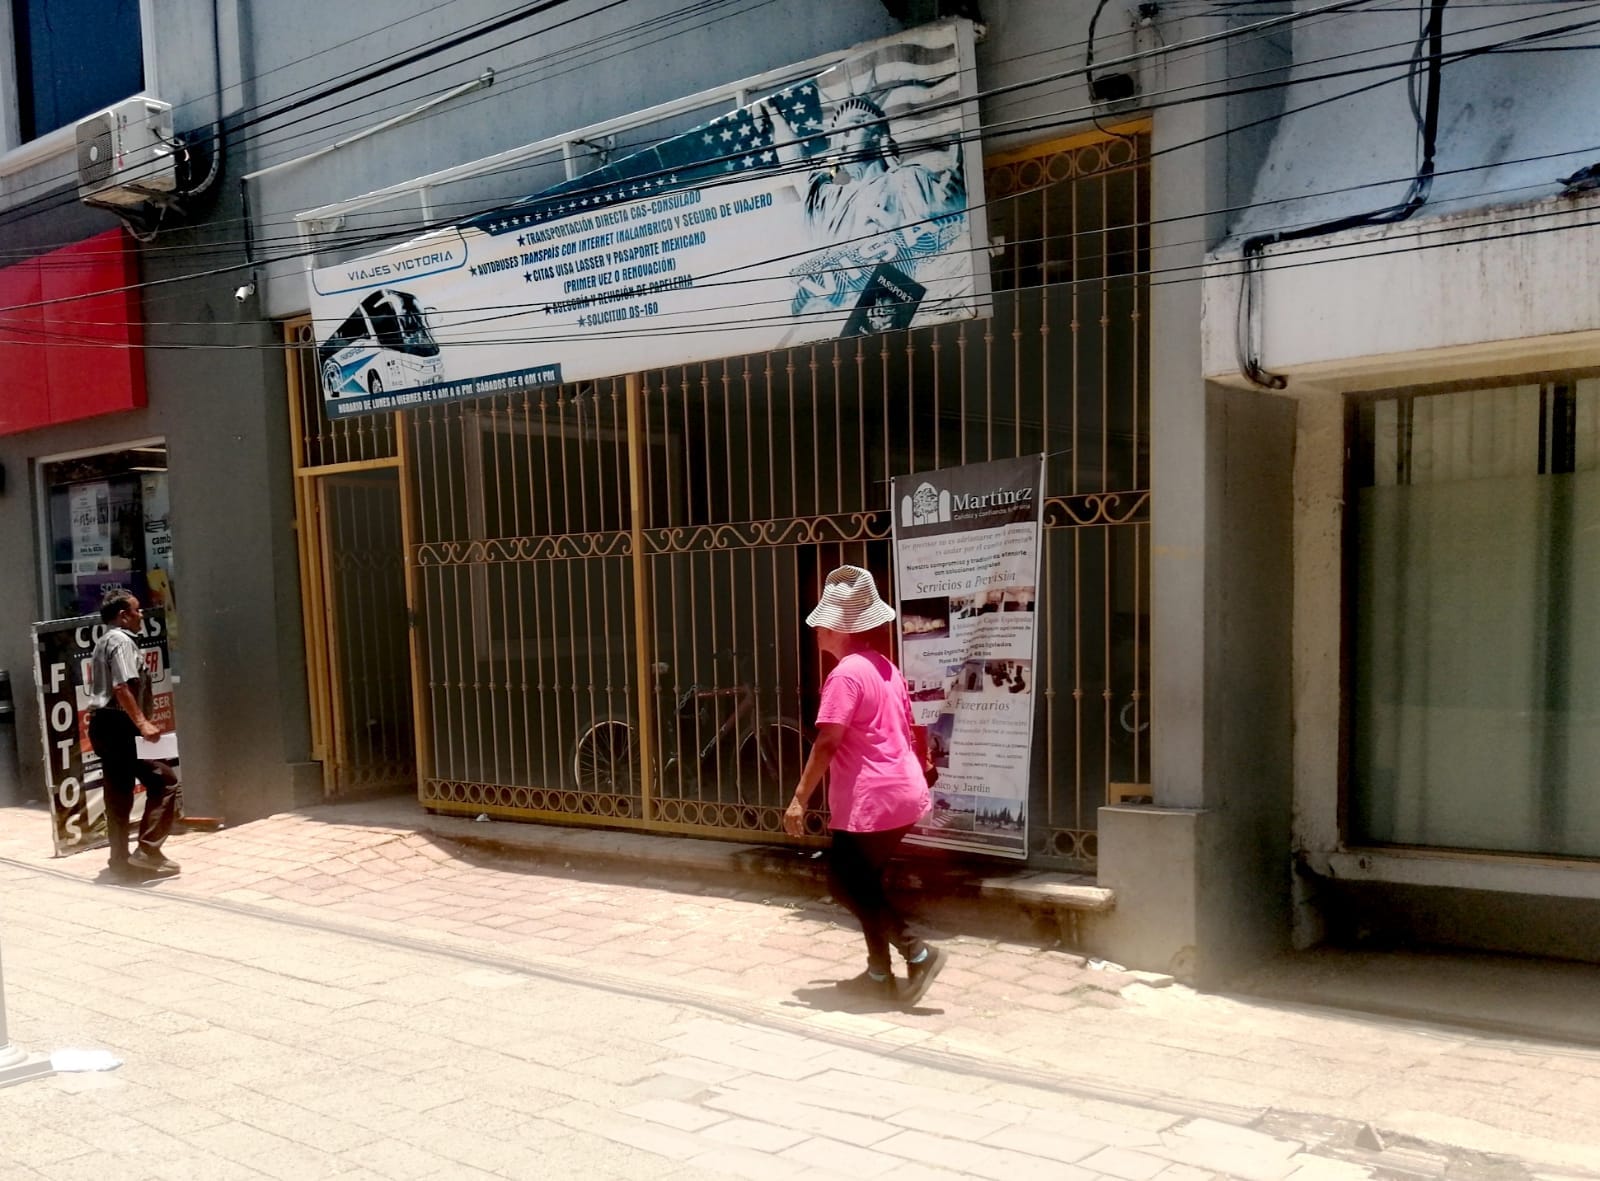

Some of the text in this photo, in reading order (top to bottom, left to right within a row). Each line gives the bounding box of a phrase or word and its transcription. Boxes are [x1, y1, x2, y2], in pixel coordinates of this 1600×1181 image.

[477, 256, 519, 276] AUTOBUSES
[561, 243, 577, 257] CON
[579, 232, 614, 252] INTERNET
[674, 216, 681, 229] Y
[683, 207, 718, 227] SEGURO
[720, 203, 732, 218] DE
[734, 193, 773, 214] VIAJERO
[526, 191, 702, 246] TRANSPORTACIÓN DIRECTA CAS-CONSULADO
[348, 251, 453, 281] VIAJES VICTORIA
[533, 231, 706, 282] CITAS VISA LASSER Y PASAPORTE MEXICANO
[799, 224, 940, 297] VISA
[563, 257, 676, 294] (PRIMER VEZ O RENOVACIÓN)
[877, 274, 914, 304] PASSPORT
[587, 301, 658, 327] SOLICITUD DS-160
[475, 378, 507, 393] SÁBADOS
[507, 376, 518, 388] DE
[542, 370, 556, 382] PM
[952, 487, 1032, 512] Martínez
[916, 580, 962, 593] Servicios
[50, 662, 82, 846] FOTOS
